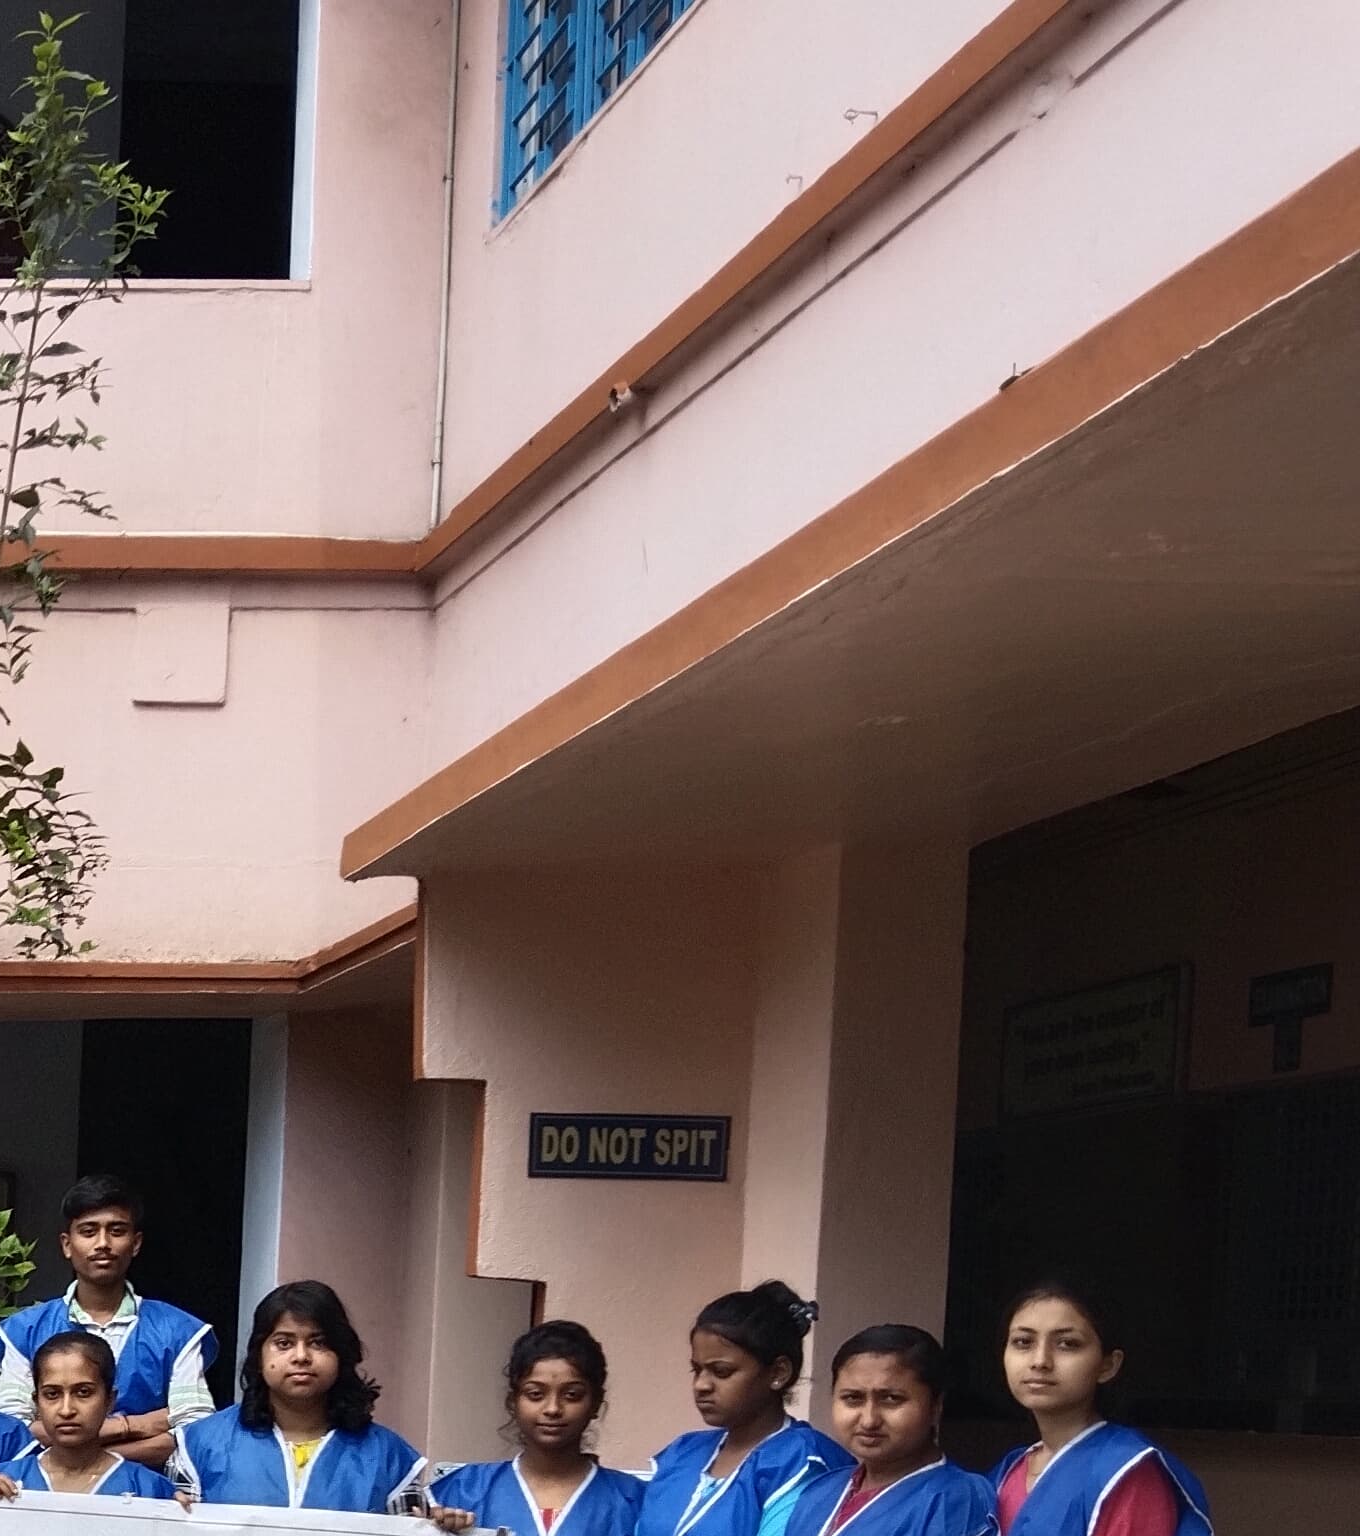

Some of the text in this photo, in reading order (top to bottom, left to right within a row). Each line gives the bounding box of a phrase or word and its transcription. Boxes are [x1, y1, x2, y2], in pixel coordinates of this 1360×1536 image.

[540, 1125, 717, 1166] DO NOT SPIT
